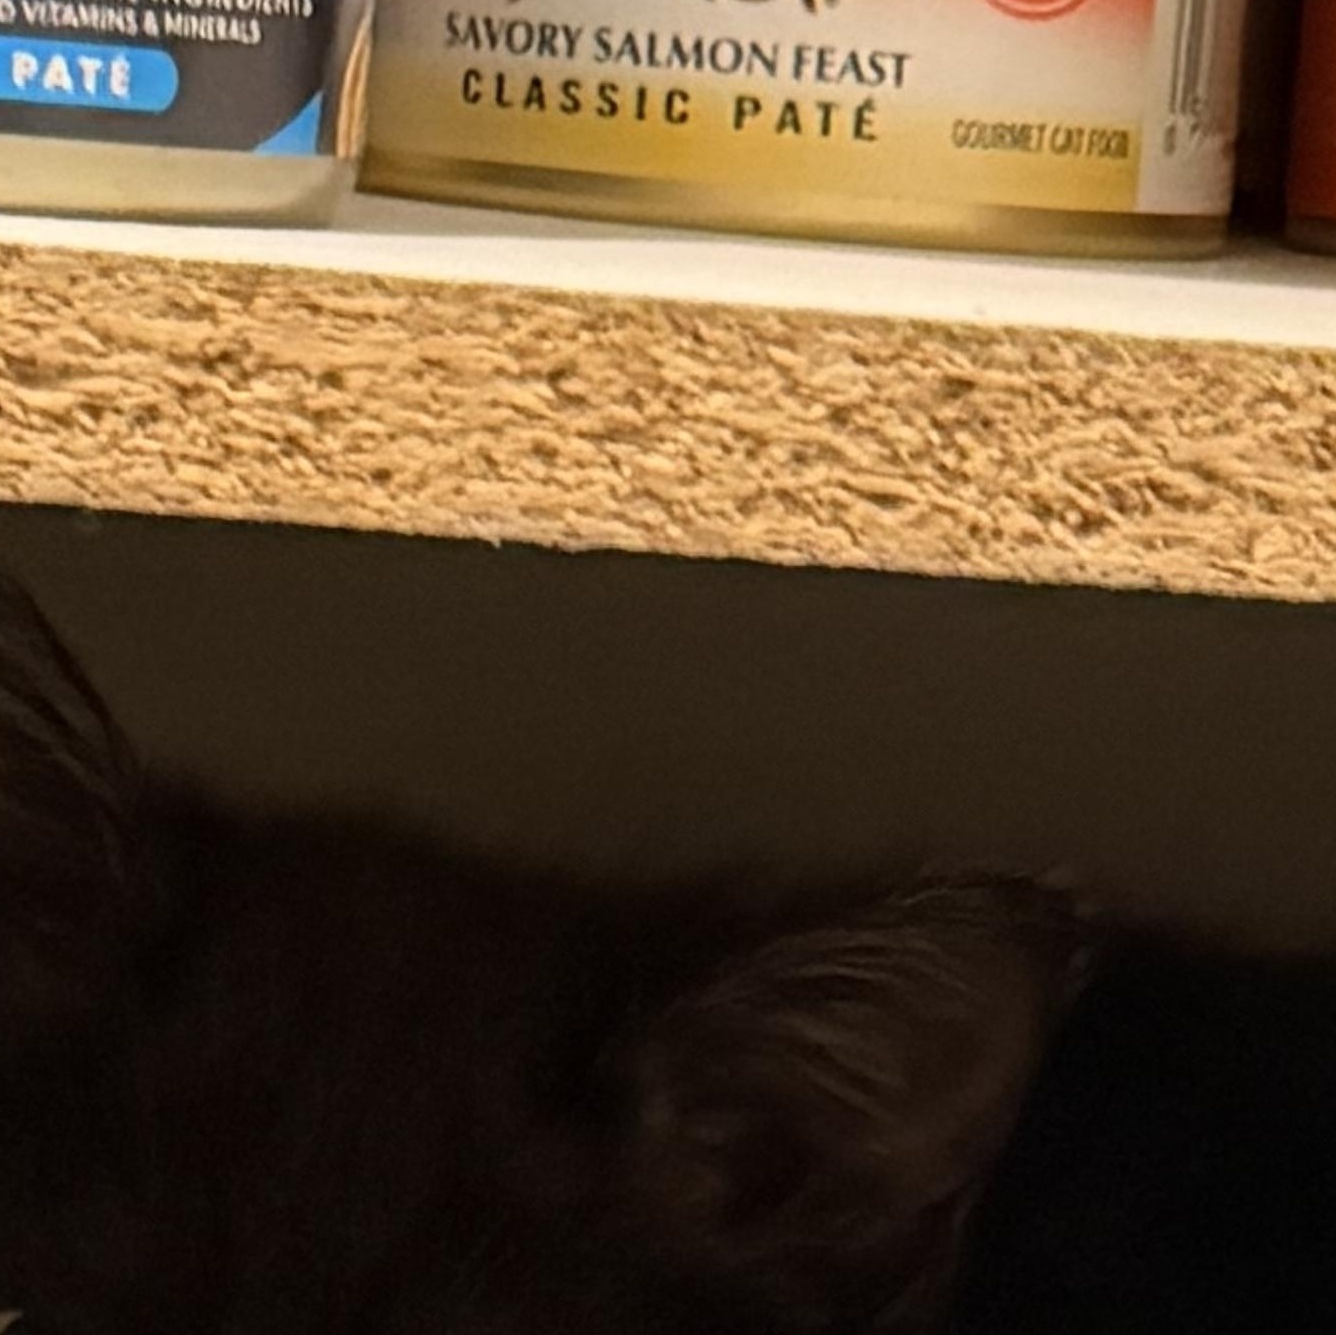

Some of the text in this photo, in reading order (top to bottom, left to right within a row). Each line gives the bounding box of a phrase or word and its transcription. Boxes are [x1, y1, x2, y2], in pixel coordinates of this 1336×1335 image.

[22, 0, 138, 37] VITAMINS
[141, 10, 160, 38] &
[164, 11, 262, 45] MINERALS
[11, 50, 131, 98] PATÉ
[444, 11, 912, 89] SAVORY SALMON FEAST
[462, 68, 878, 142] CLASSIC PATÉ
[951, 118, 1046, 152] GOURMET
[1049, 124, 1084, 156] CAT
